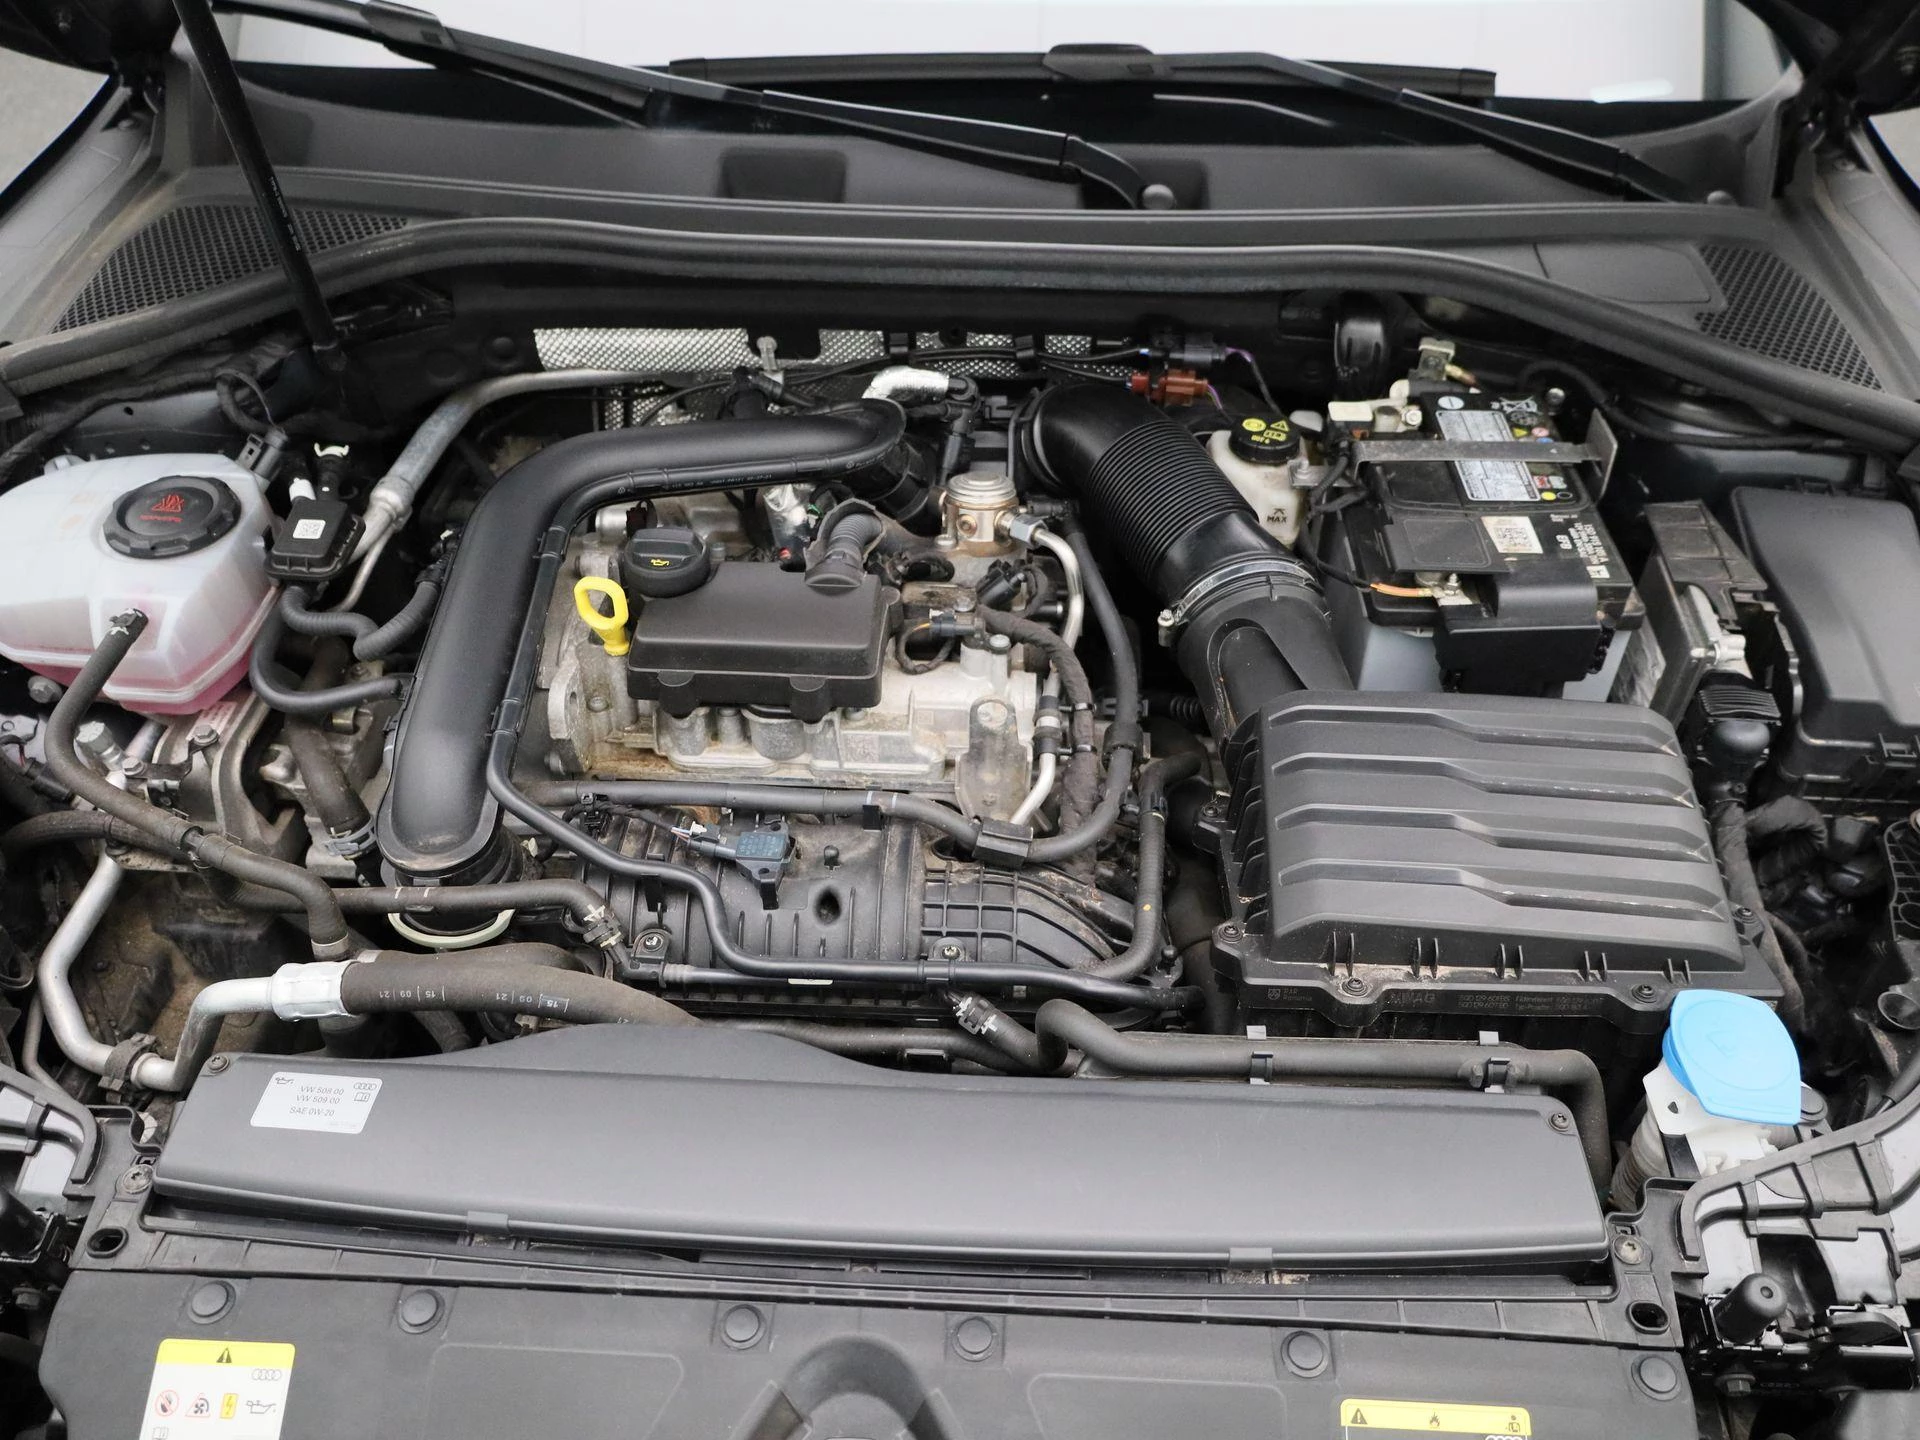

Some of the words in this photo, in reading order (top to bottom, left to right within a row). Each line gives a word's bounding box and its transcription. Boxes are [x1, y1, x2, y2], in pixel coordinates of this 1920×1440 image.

[1266, 515, 1287, 523] MAX
[300, 1085, 317, 1093] VW
[296, 1094, 312, 1102] VW
[312, 1095, 328, 1103] 509
[289, 1106, 308, 1115] SAE
[308, 1107, 335, 1117] 0W-20
